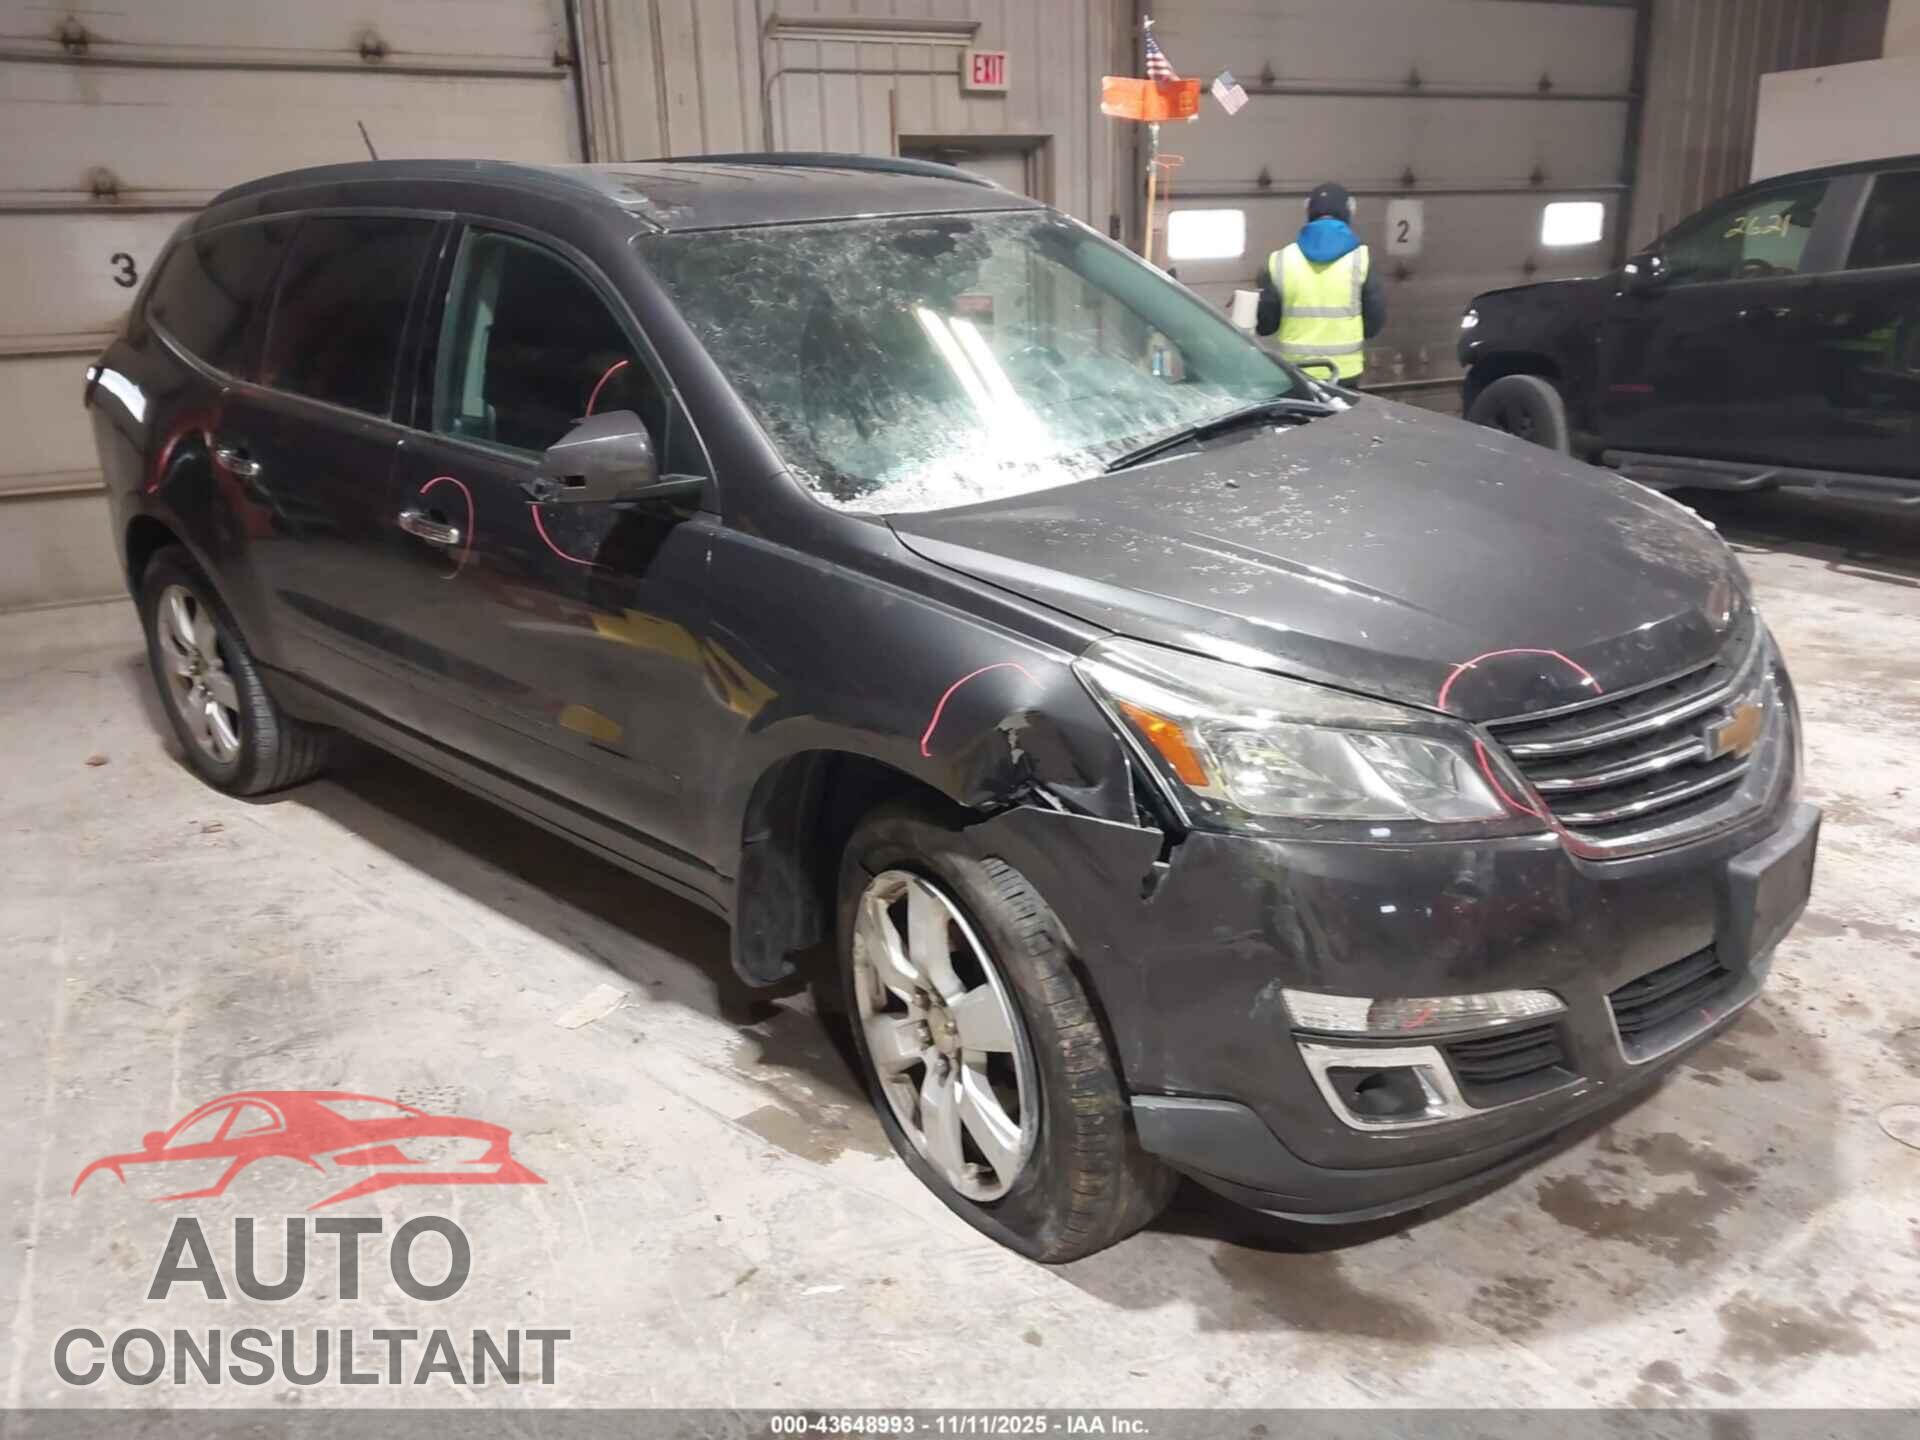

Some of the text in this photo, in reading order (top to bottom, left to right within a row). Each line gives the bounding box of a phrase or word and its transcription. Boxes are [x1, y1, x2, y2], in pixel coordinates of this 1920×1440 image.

[974, 54, 1006, 84] EXIT
[1396, 219, 1410, 244] 2
[111, 252, 138, 288] 3
